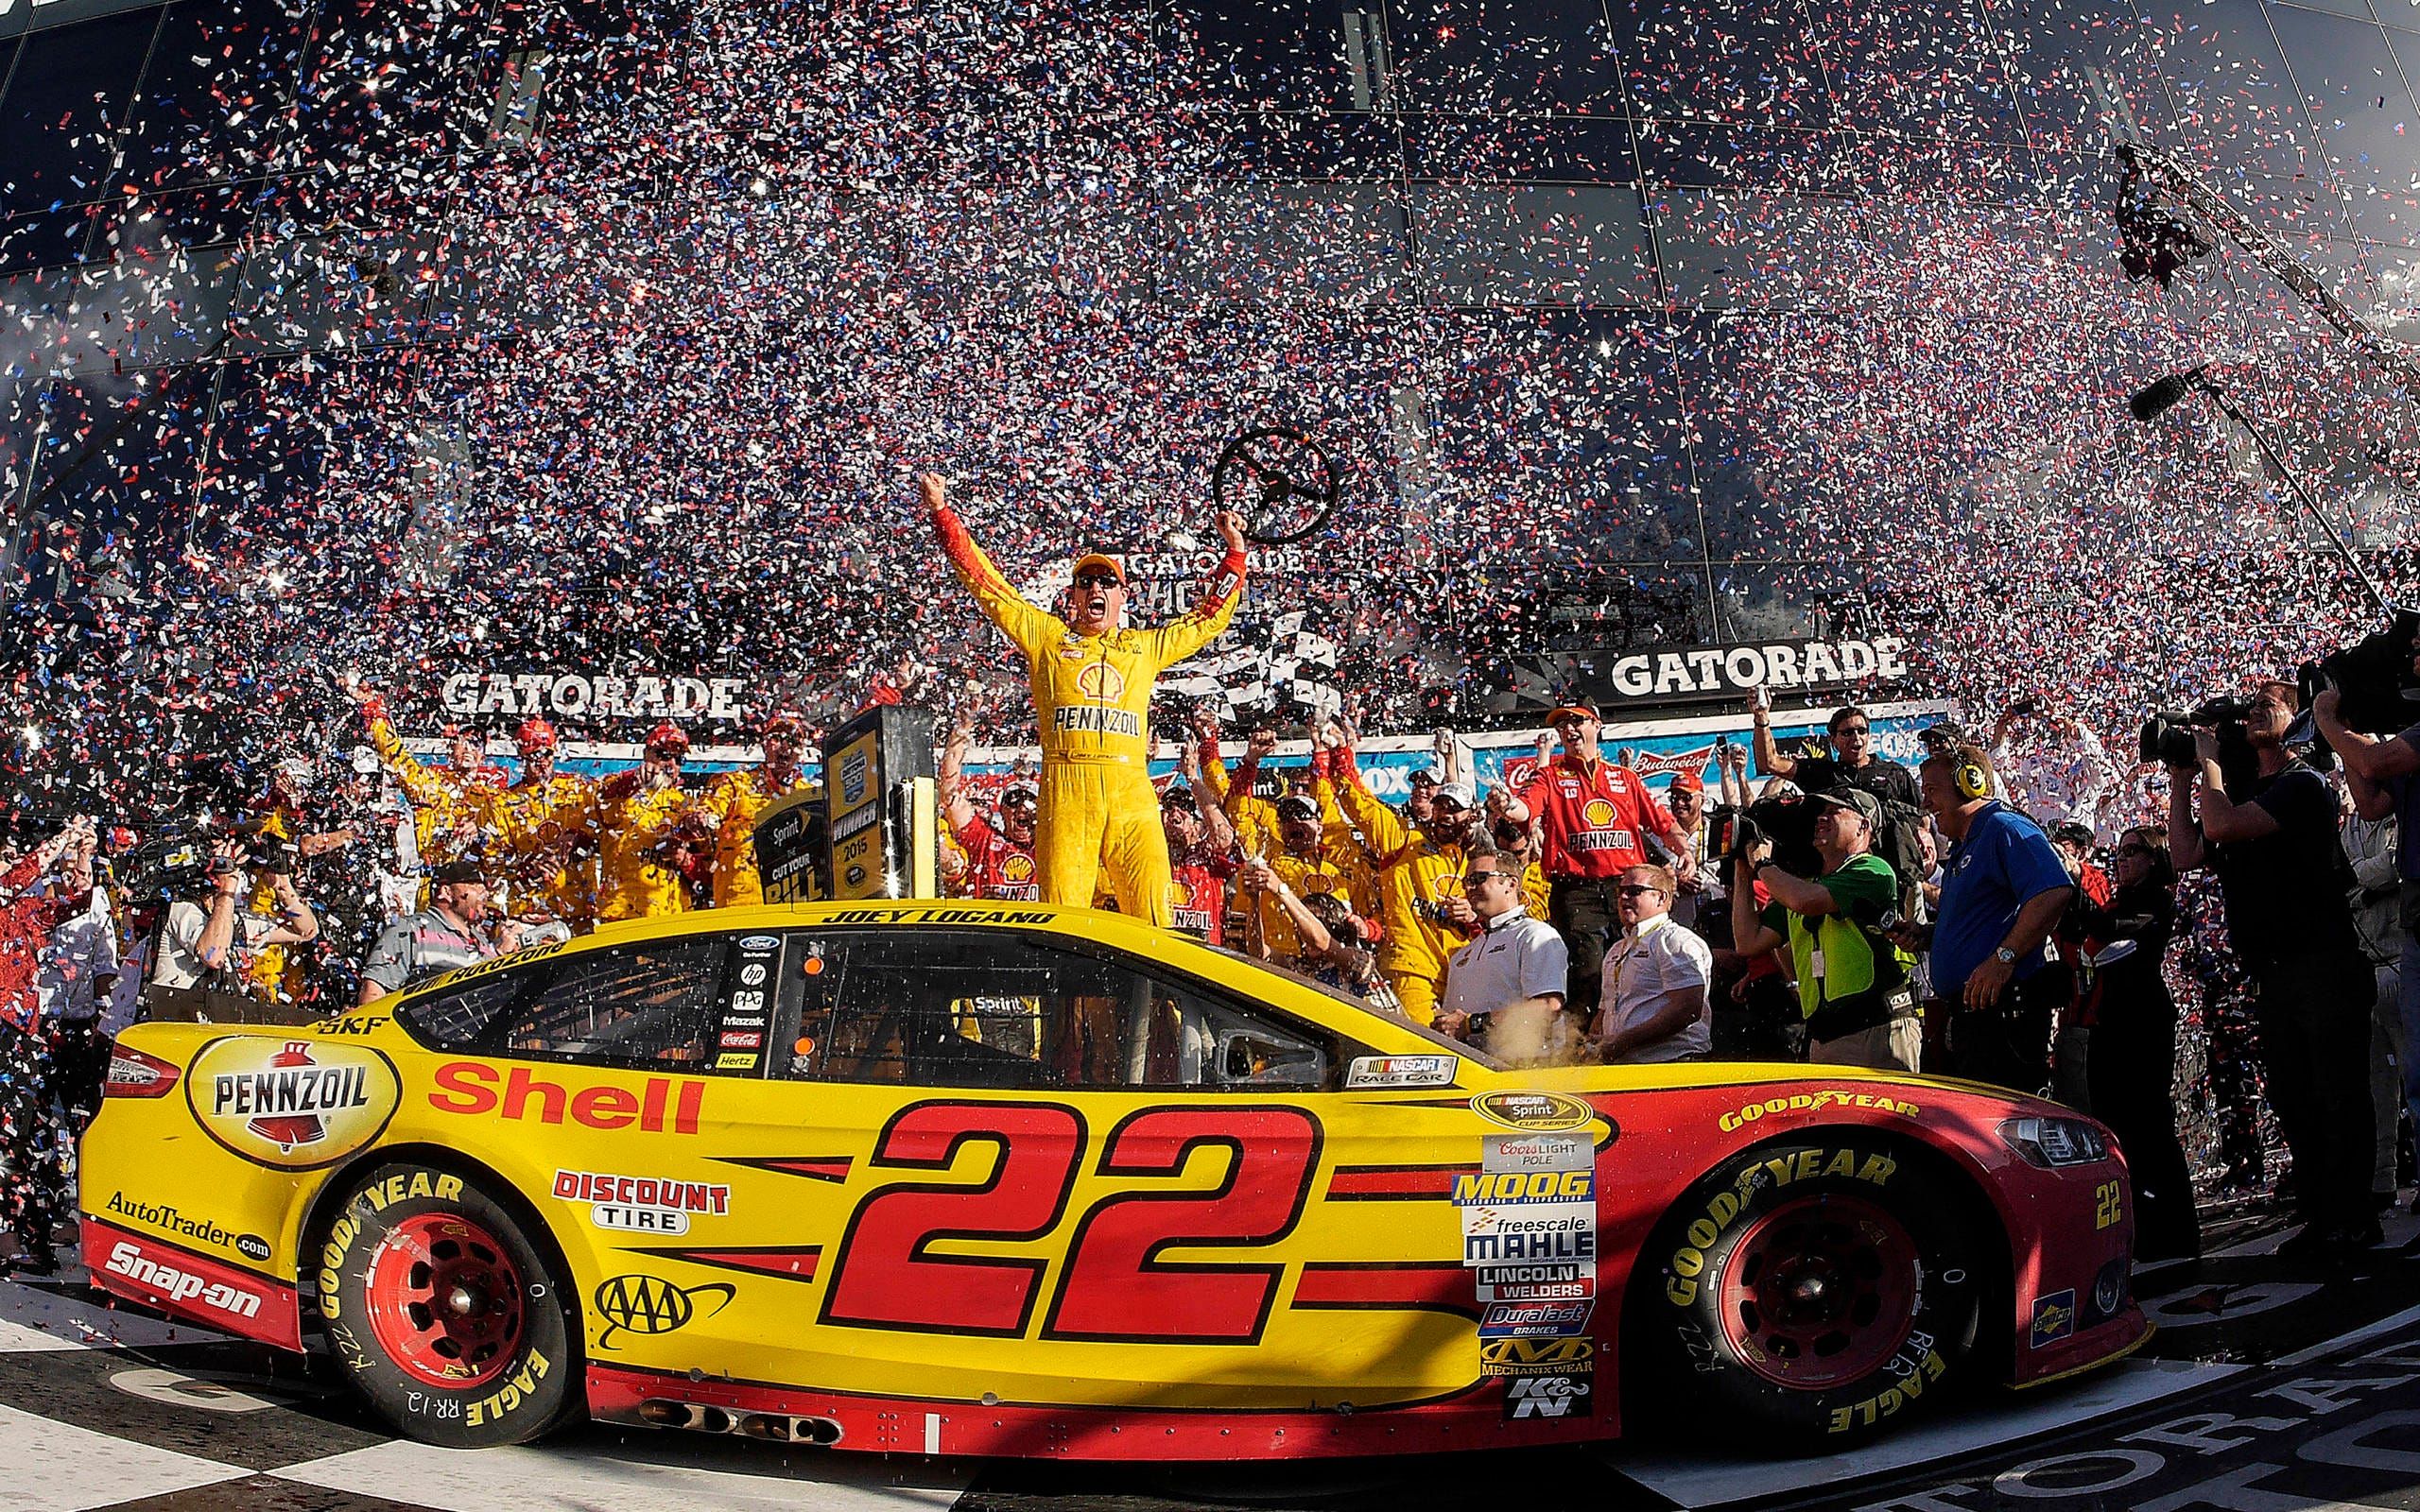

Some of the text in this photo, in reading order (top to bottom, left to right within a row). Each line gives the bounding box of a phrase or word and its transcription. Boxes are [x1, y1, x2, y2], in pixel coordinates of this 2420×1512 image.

[1129, 550, 1305, 576] GATOADE
[1612, 636, 1908, 696] GATORADE
[441, 672, 748, 718] GATORADE
[1053, 706, 1140, 737] PENNZOIL
[1252, 780, 1274, 797] int
[1361, 765, 1410, 795] OX
[772, 816, 801, 848] Sprint
[833, 801, 877, 843] WINNER
[843, 836, 868, 862] 2015
[1567, 831, 1634, 853] PENNZOIL
[771, 852, 811, 881] CUT YOUR
[822, 909, 1058, 925] JOEY LOGANO
[1174, 909, 1215, 931] NZOIL
[449, 941, 568, 984] AutoZone
[744, 964, 763, 986] hp
[735, 991, 762, 1007] PPG
[975, 996, 1022, 1013] Sprint
[318, 1016, 390, 1036] SKF
[722, 1016, 765, 1027] Mazak
[720, 1056, 752, 1066] Hertz
[1388, 1059, 1438, 1073] NASCAR
[1354, 1073, 1443, 1084] RACE CAR
[214, 1065, 370, 1116] PENNZOIL
[428, 1061, 706, 1135] Shell
[1504, 1096, 1545, 1106] NASCAR
[1512, 1105, 1552, 1118] Sprint
[1718, 1090, 1921, 1133] GOODYEAR
[1498, 1141, 1578, 1155] Coors LIGHT
[1522, 1155, 1553, 1166] POLE
[552, 1171, 729, 1215] DISCOUNT
[1454, 1171, 1592, 1200] MOOG
[2095, 1179, 2122, 1230] 22
[602, 1207, 677, 1230] TIRE
[816, 1099, 1325, 1347] 22
[1496, 1215, 1587, 1233] freescale
[1466, 1230, 1594, 1261] MAHLE
[104, 1241, 262, 1318] Snap-on
[1482, 1265, 1574, 1283] LINCOLN
[1503, 1284, 1583, 1298] WELDERS
[601, 1275, 687, 1333] AAA
[1489, 1304, 1584, 1324] Duralast
[1512, 1326, 1559, 1335] BRAKES
[1481, 1360, 1593, 1377] MECHANIX WEAR
[466, 1347, 550, 1428] EAGLE
[1827, 1349, 1946, 1434] EAGLE
